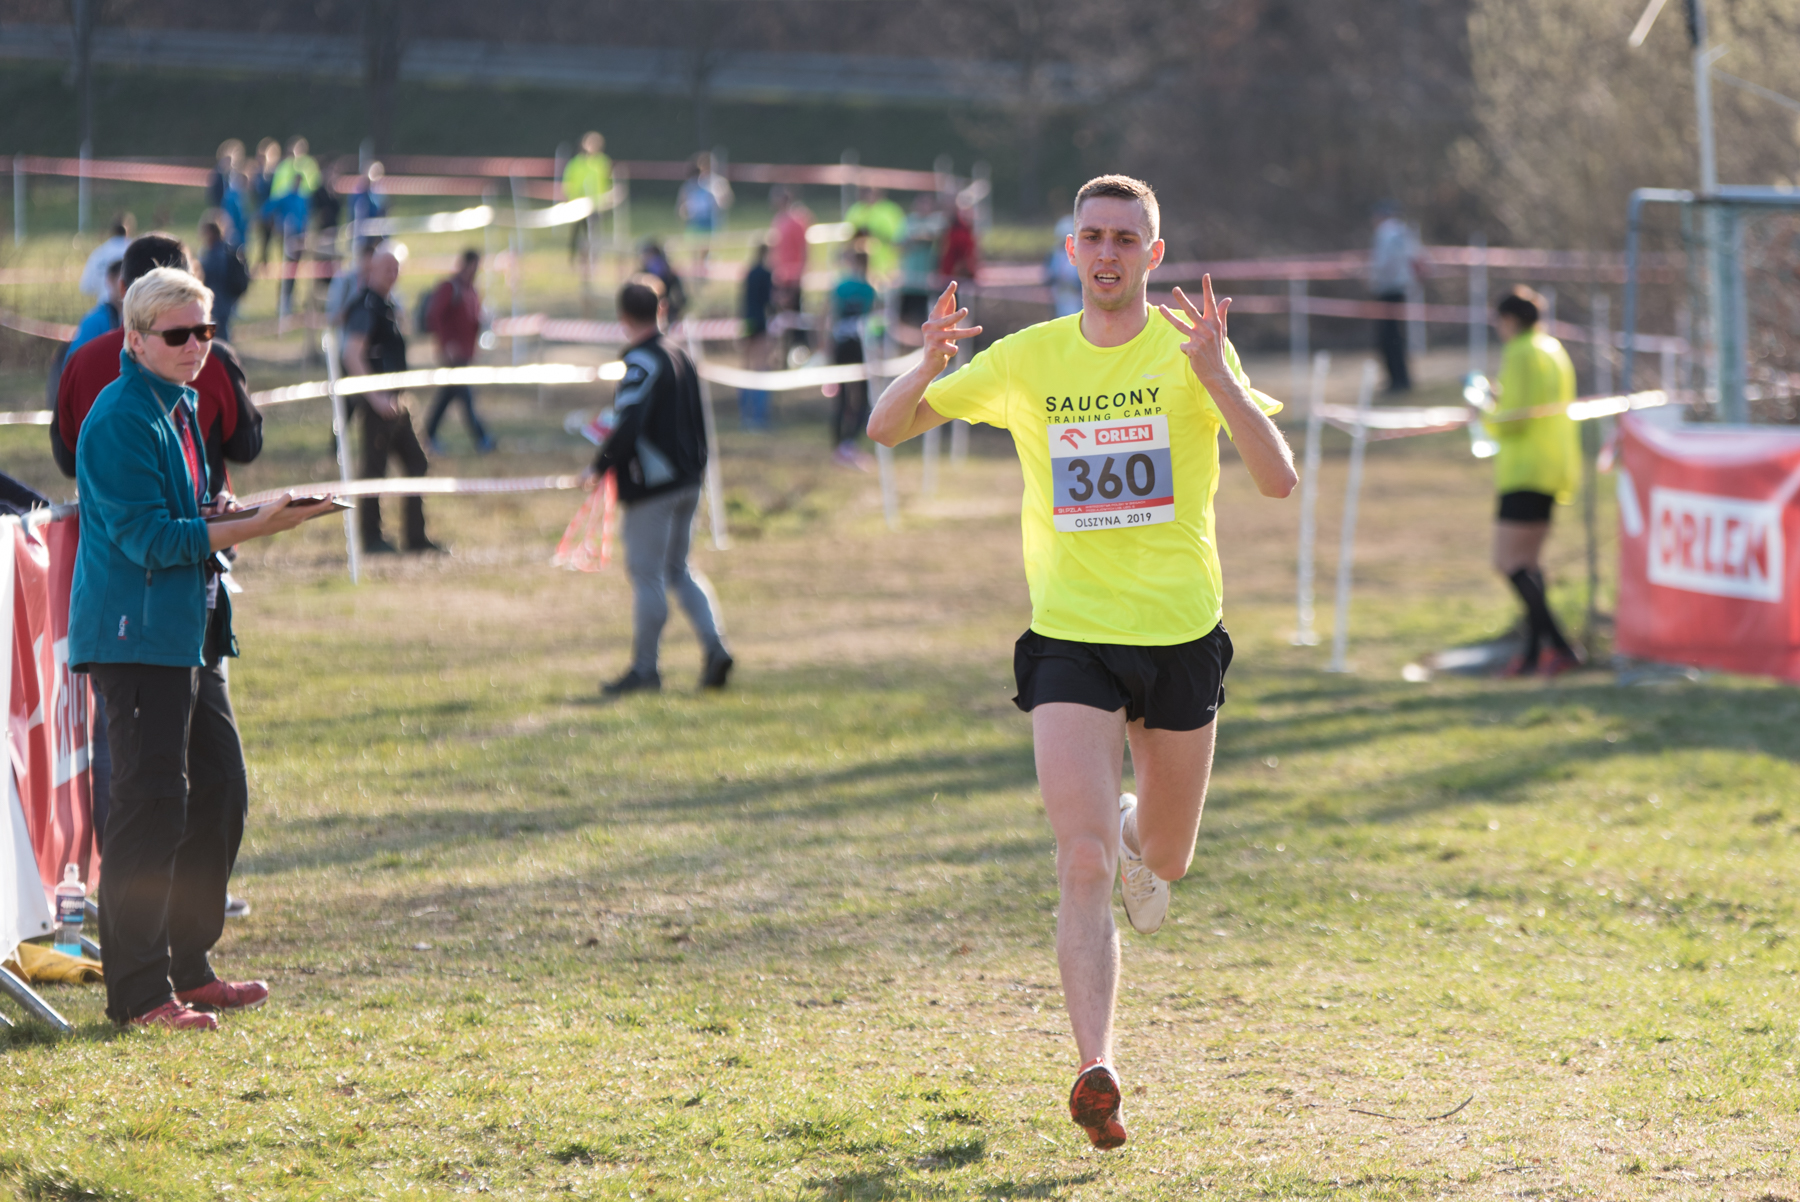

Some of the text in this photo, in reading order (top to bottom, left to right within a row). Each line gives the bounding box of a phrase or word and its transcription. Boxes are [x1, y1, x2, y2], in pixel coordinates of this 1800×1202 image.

[1045, 387, 1160, 412] SAUCONY
[1047, 406, 1162, 424] TRAINING CAMP
[1097, 426, 1151, 444] ORLEN
[1067, 453, 1156, 503] 360
[1075, 512, 1152, 528] OLSZYNA 2019
[1660, 509, 1769, 581] ORLEN
